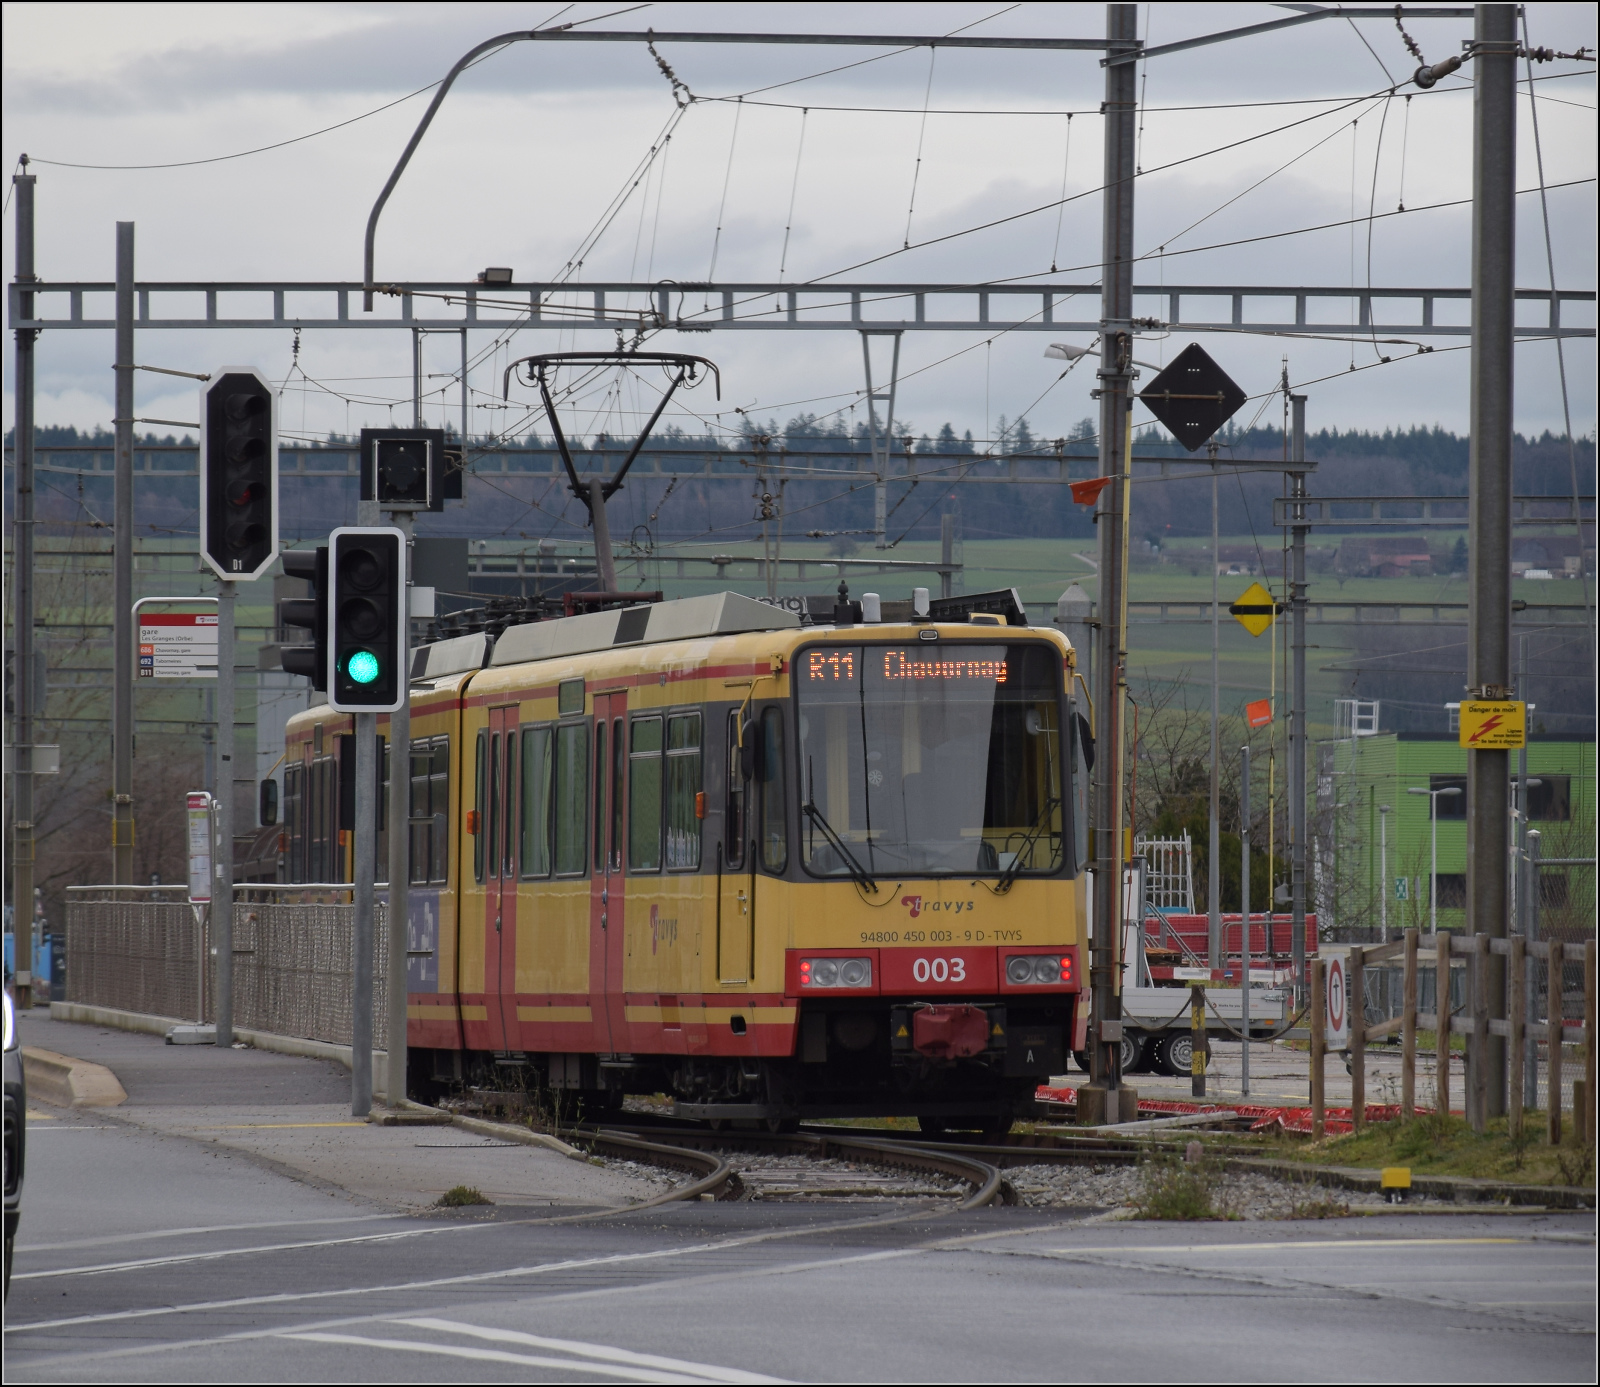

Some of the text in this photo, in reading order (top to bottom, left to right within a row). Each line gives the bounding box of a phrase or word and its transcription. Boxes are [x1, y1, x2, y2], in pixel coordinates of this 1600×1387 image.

[232, 559, 243, 571] D1
[809, 651, 1008, 683] R11 Chavornay
[1485, 686, 1499, 697] 67
[1468, 706, 1492, 714] Danger
[907, 896, 975, 915] travys
[652, 908, 678, 949] travys
[860, 931, 899, 943] 94800
[903, 930, 926, 942] 450
[930, 930, 953, 942] 003
[964, 930, 972, 941] 9
[976, 930, 985, 941] D
[994, 929, 1023, 942] TVYS
[912, 957, 966, 983] 003
[1026, 1049, 1035, 1063] A
